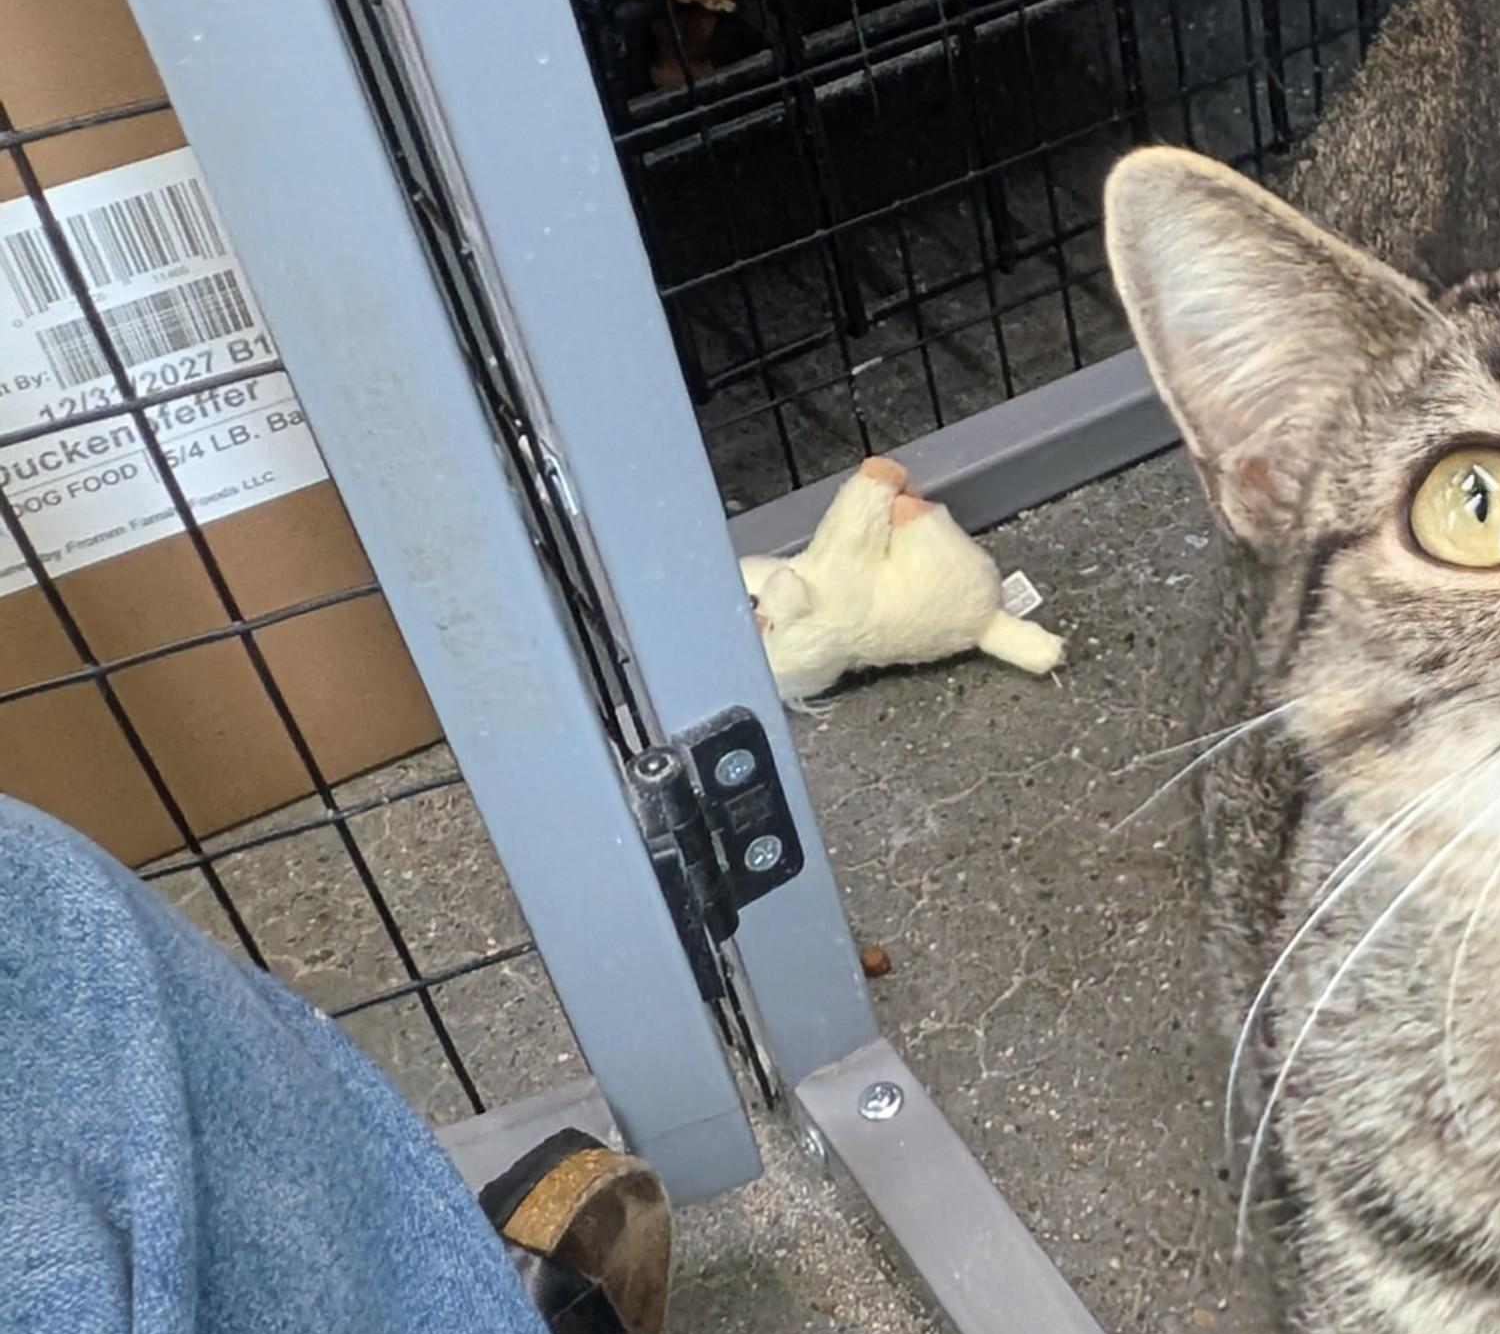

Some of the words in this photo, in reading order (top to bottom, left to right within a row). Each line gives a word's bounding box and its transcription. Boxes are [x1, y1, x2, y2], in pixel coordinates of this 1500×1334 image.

[14, 370, 52, 391] By:
[0, 379, 258, 487] uckenfeffer
[166, 441, 205, 469] 5/4
[211, 424, 260, 452] LB.
[67, 463, 138, 499] FOOD
[65, 525, 126, 553] Fromm
[129, 506, 178, 530] Famil
[242, 471, 275, 490] LLC
